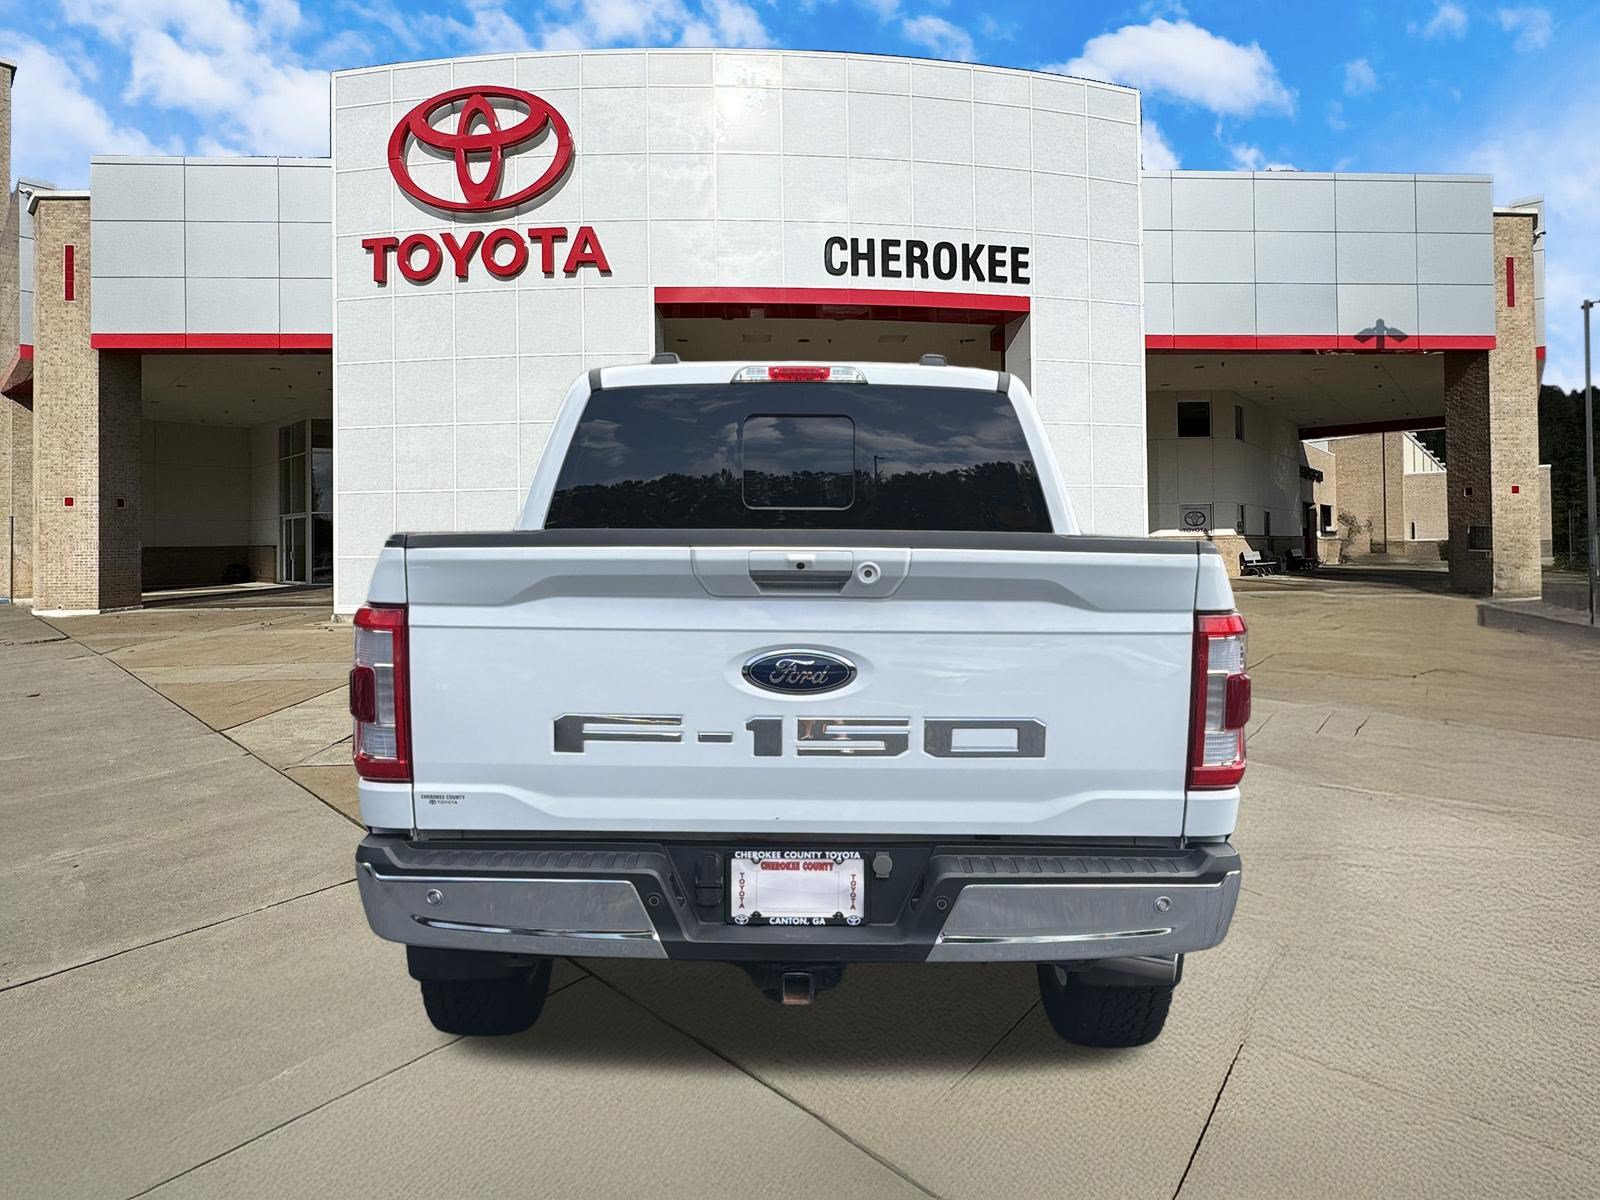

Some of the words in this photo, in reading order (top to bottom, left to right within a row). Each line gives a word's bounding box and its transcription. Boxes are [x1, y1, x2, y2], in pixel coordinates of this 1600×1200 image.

[361, 226, 613, 286] TOYOTA
[824, 235, 1031, 285] CHEROKEE
[768, 658, 830, 686] Ford
[552, 712, 1047, 759] F-150
[734, 851, 781, 859] CHEROKEE
[784, 851, 822, 859] COUNTY
[825, 851, 861, 859] TOYOTA
[760, 861, 800, 871] CHEROKEE
[802, 861, 834, 871] COUNTY
[769, 917, 810, 926] CANTON,
[812, 917, 826, 925] GA
